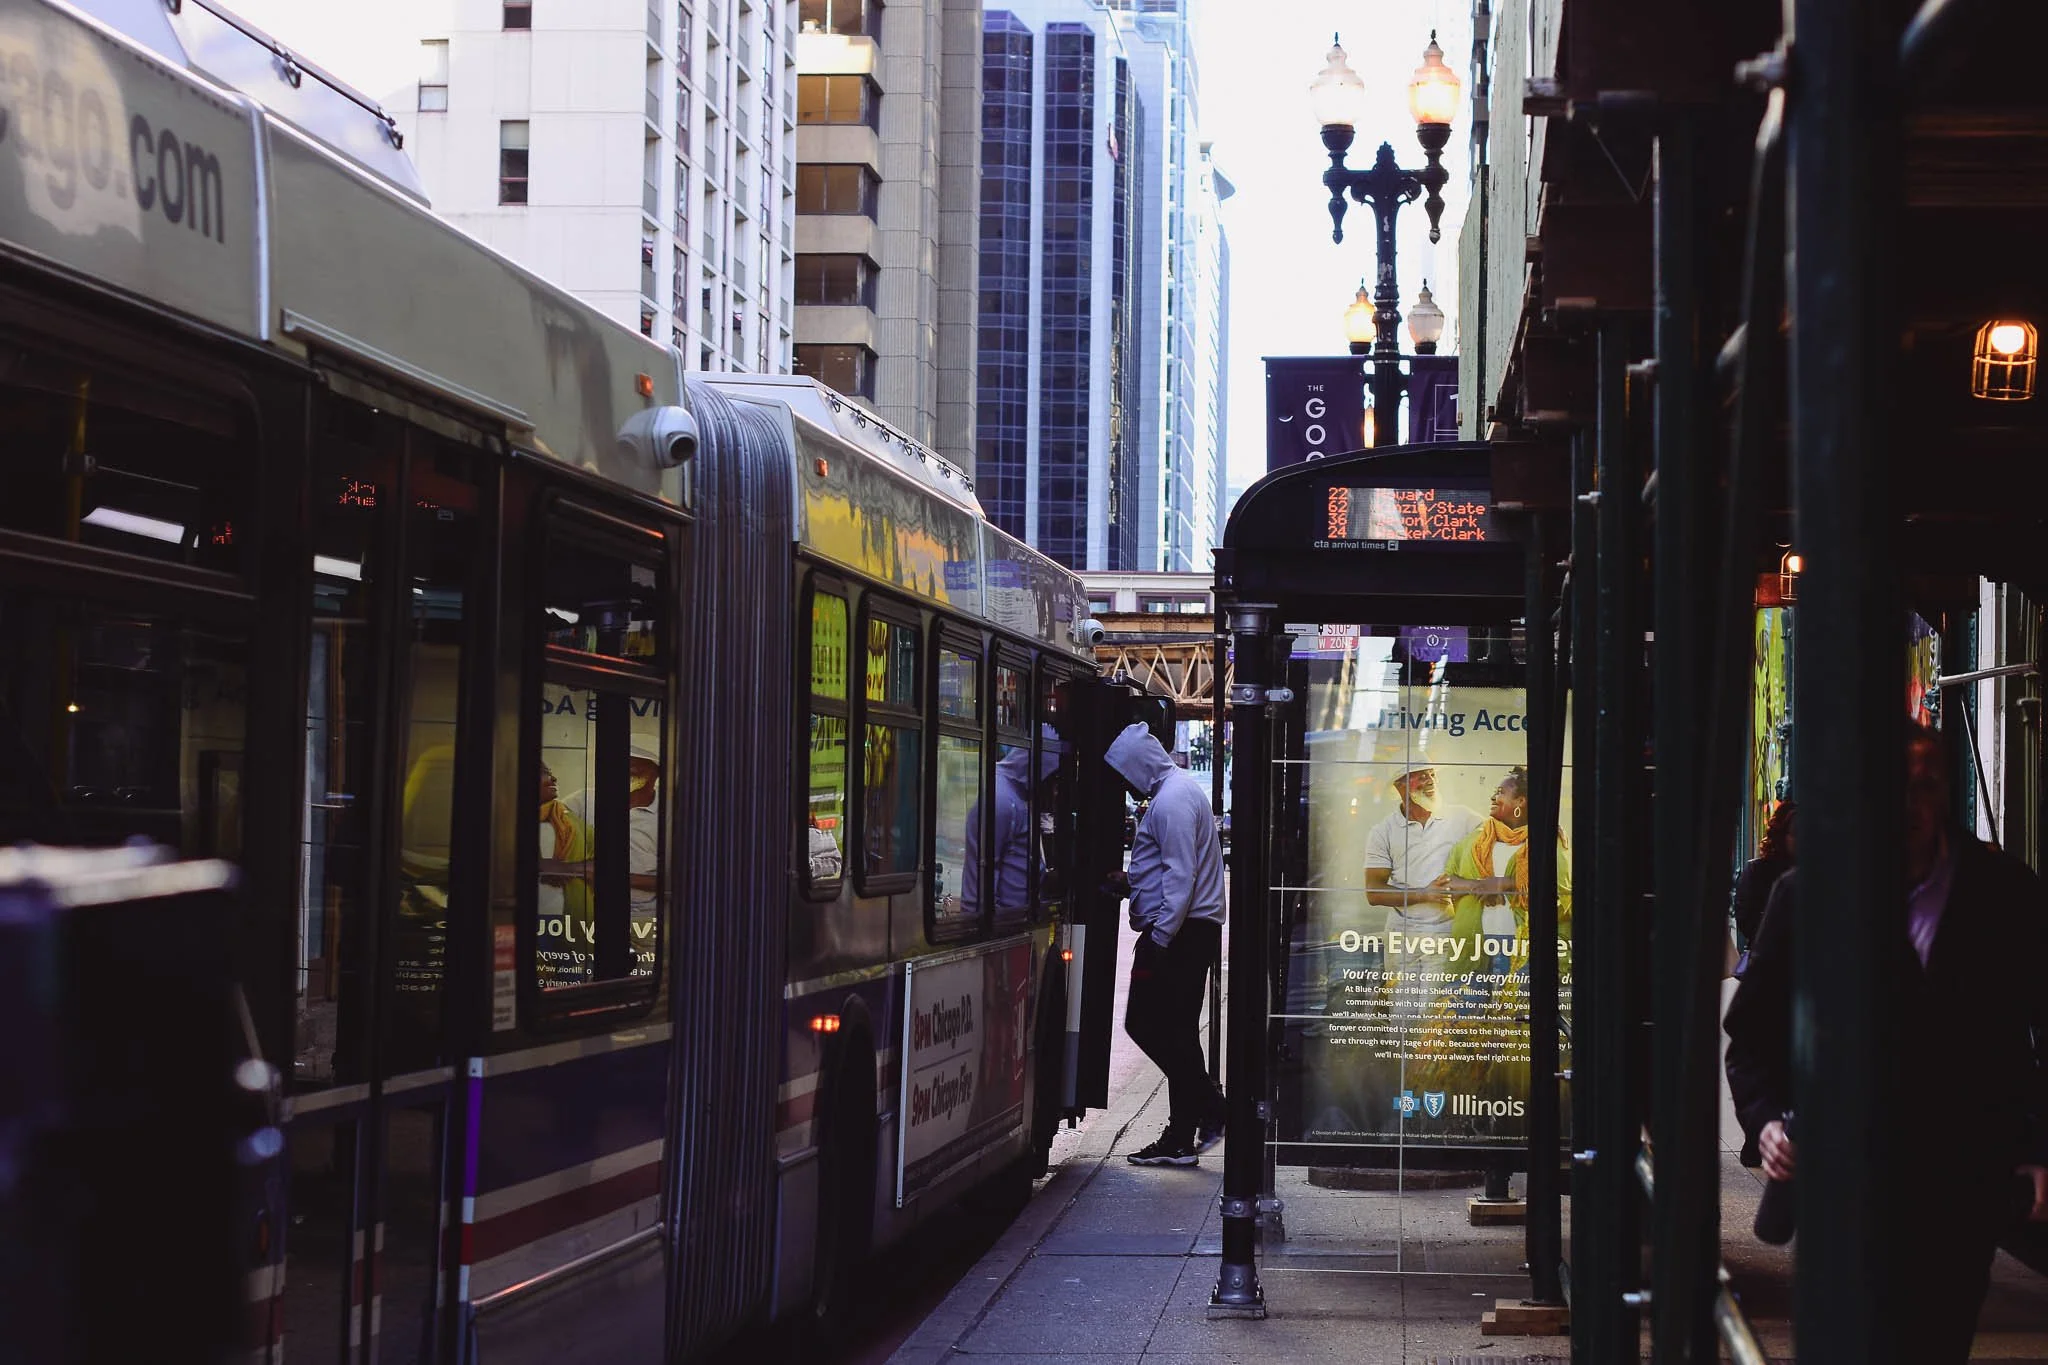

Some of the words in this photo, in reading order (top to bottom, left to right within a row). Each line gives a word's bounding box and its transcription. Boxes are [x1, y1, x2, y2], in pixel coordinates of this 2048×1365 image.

[0, 48, 224, 244] ago.com
[1329, 488, 1348, 500] 22
[1328, 502, 1347, 512] 62
[1328, 526, 1347, 538] 24
[1332, 541, 1359, 549] arrival
[1328, 625, 1352, 634] STOP
[1340, 930, 1378, 952] On
[1388, 931, 1466, 962] Every
[1343, 968, 1379, 980] You're
[1382, 971, 1394, 980] at
[1420, 971, 1458, 982] center
[1460, 971, 1475, 985] of
[1476, 972, 1530, 986] everythin
[1428, 1000, 1464, 1008] members
[1478, 1002, 1502, 1010] nearly
[932, 999, 960, 1049] Chicago
[1329, 1024, 1356, 1032] forever
[1358, 1025, 1398, 1033] committed
[1410, 1027, 1442, 1036] ensuring
[1494, 1028, 1521, 1037] highest
[1348, 1037, 1378, 1046] through
[1380, 1040, 1400, 1048] every
[1449, 1040, 1480, 1048] Because
[1518, 1042, 1530, 1050] you
[1449, 1053, 1474, 1062] always
[1492, 1054, 1510, 1063] right
[931, 1072, 959, 1120] Chicago
[1452, 1094, 1524, 1116] Illinois
